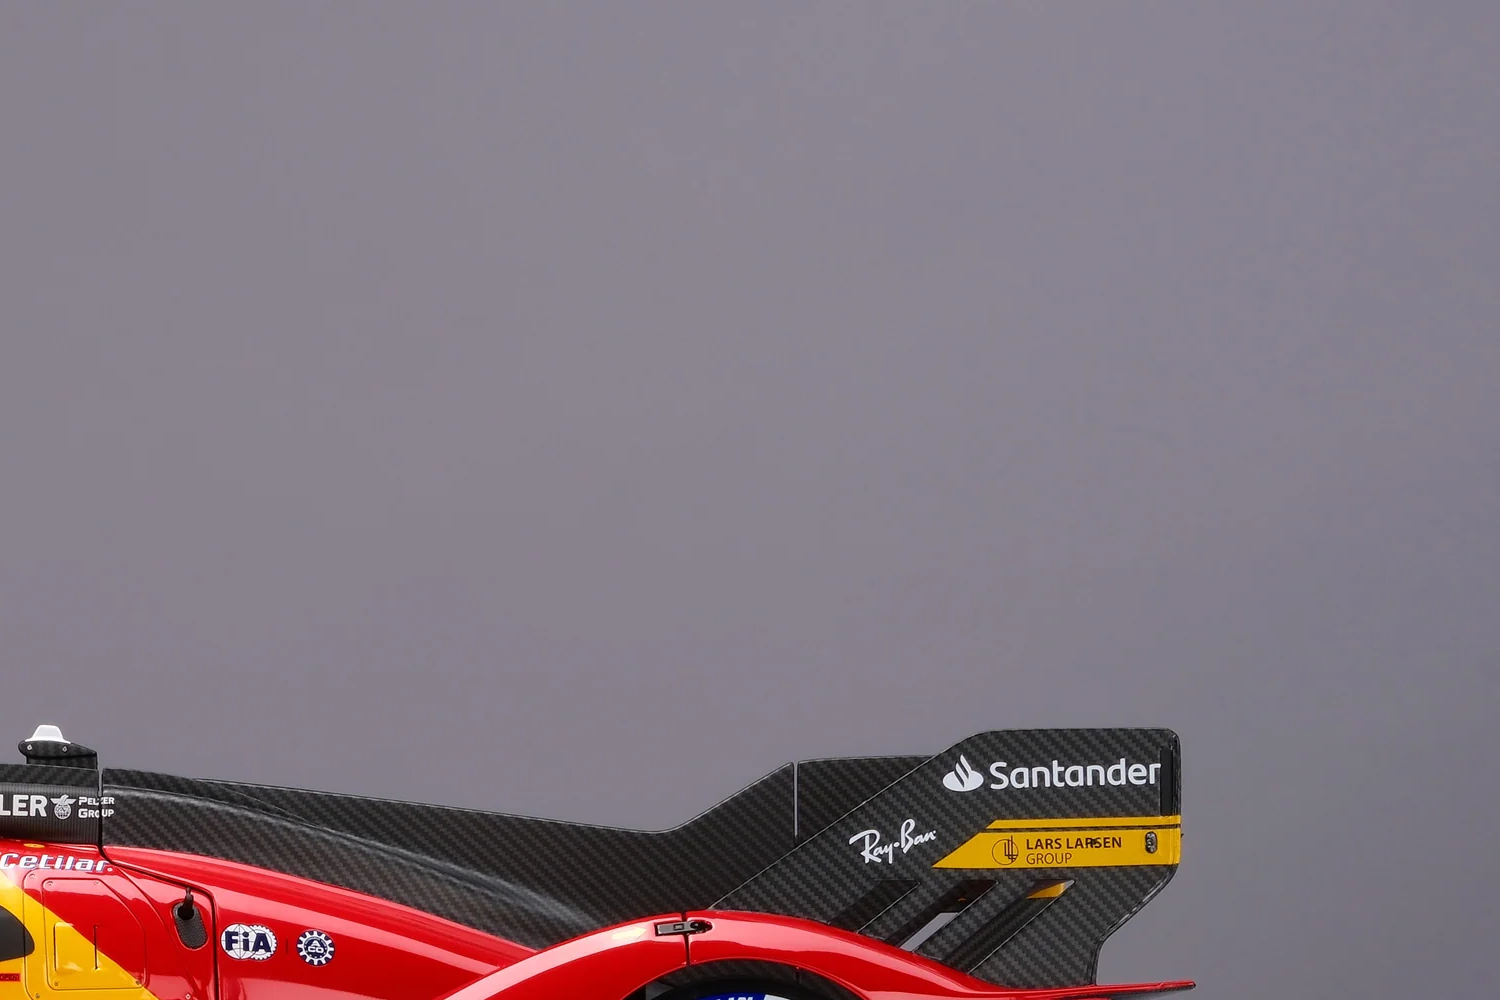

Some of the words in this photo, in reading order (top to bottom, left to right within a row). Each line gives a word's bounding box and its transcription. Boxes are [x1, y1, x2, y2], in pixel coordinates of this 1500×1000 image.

[989, 758, 1161, 790] Santander
[1026, 837, 1062, 851] LARS
[1066, 835, 1123, 850] LARSEN
[1026, 852, 1073, 865] GROUP
